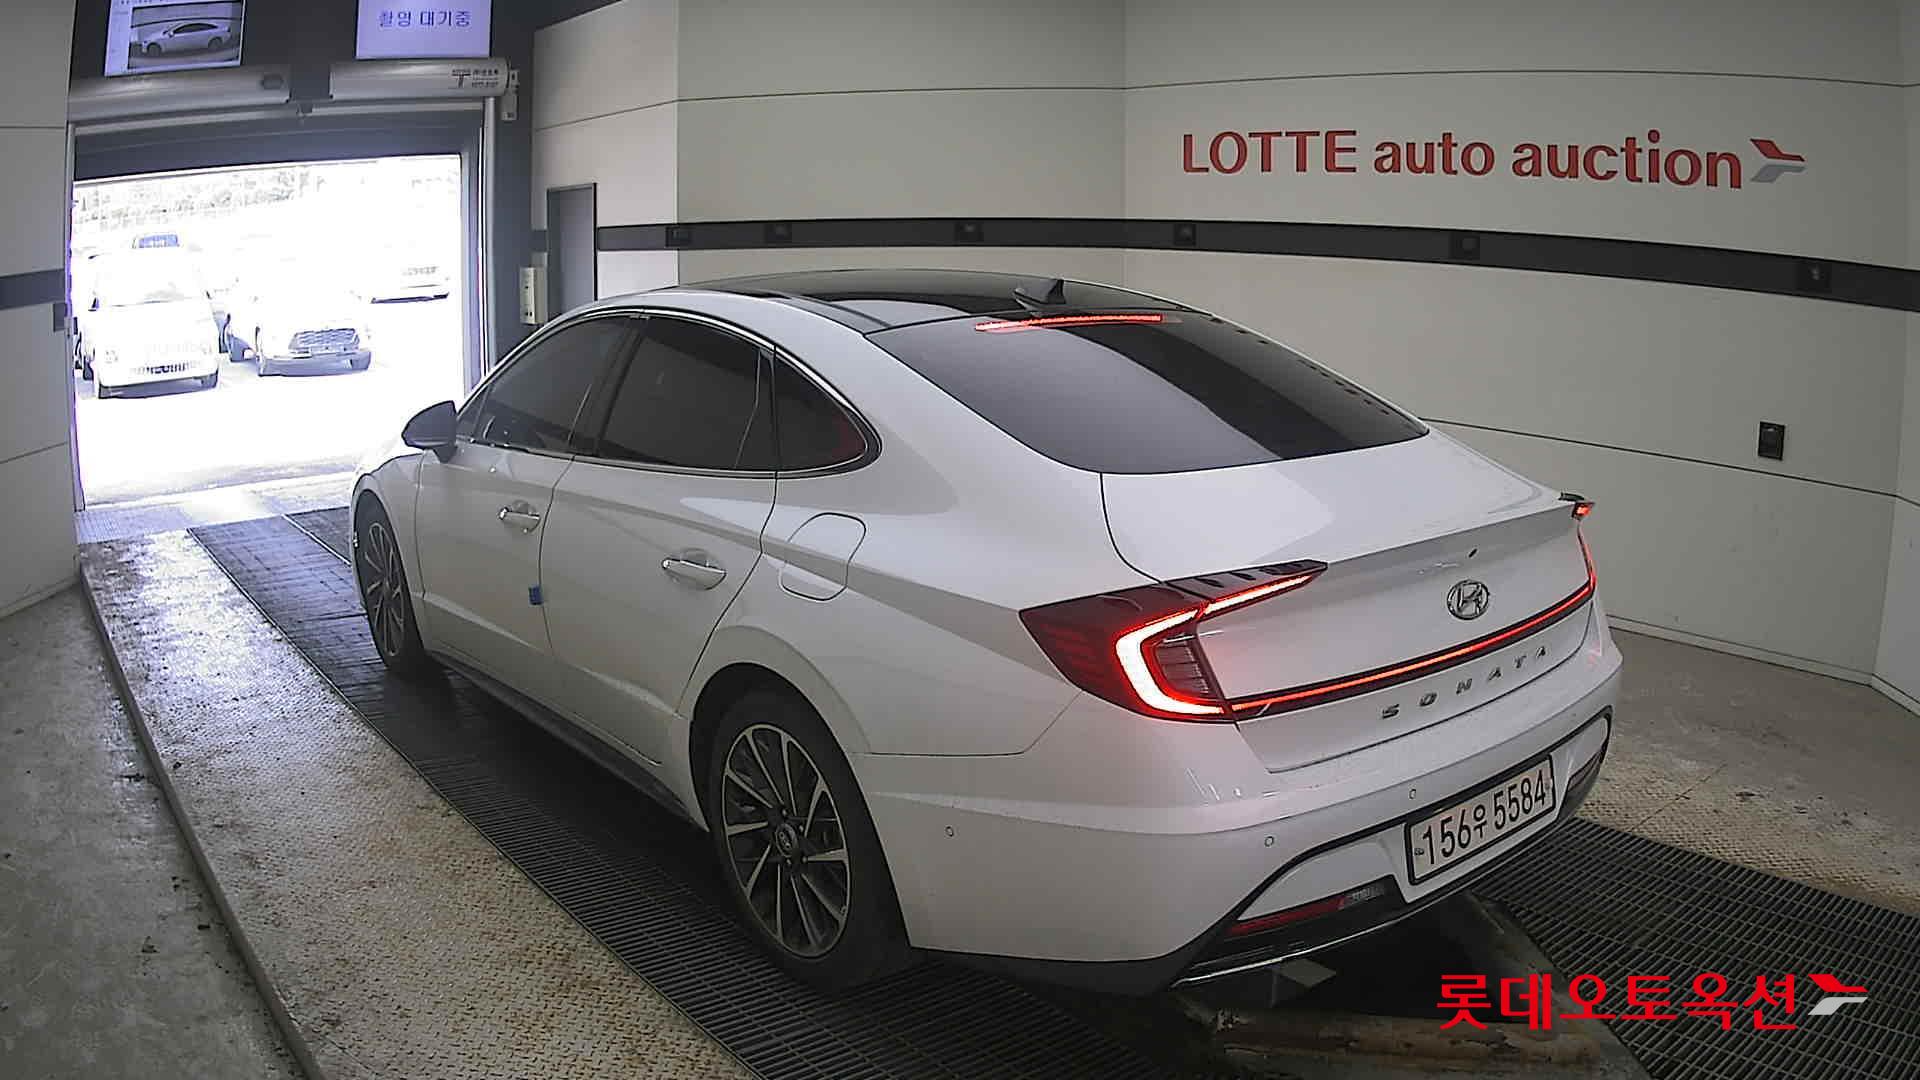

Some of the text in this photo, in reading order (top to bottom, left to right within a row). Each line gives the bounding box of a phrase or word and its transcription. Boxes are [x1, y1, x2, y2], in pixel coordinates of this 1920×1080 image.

[420, 10, 471, 27] 대기중
[1183, 130, 1742, 189] LOTTE auto auction
[1381, 646, 1547, 719] SONATA
